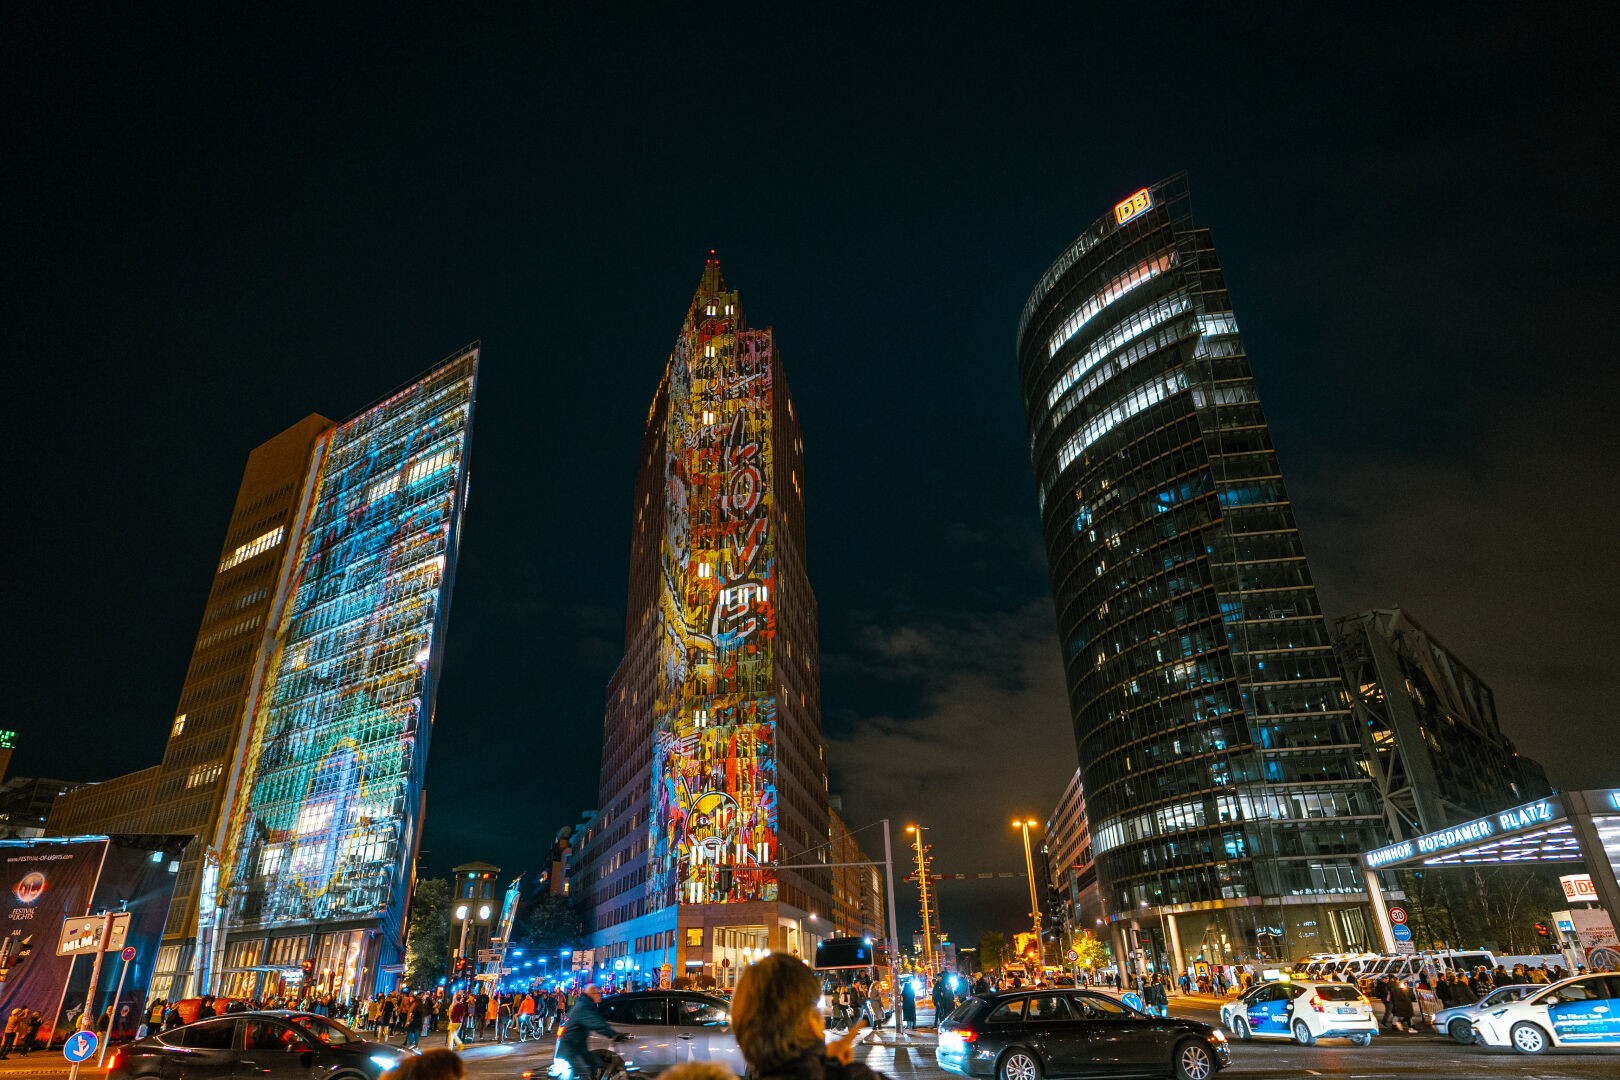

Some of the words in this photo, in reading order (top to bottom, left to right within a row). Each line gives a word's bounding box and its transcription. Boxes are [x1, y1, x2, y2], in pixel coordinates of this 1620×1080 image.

[1119, 194, 1147, 220] DB
[1366, 844, 1412, 866] BAHNHOF
[1418, 821, 1490, 852] POTSDAMER
[1499, 803, 1550, 829] PLATZ
[1393, 911, 1403, 919] 30
